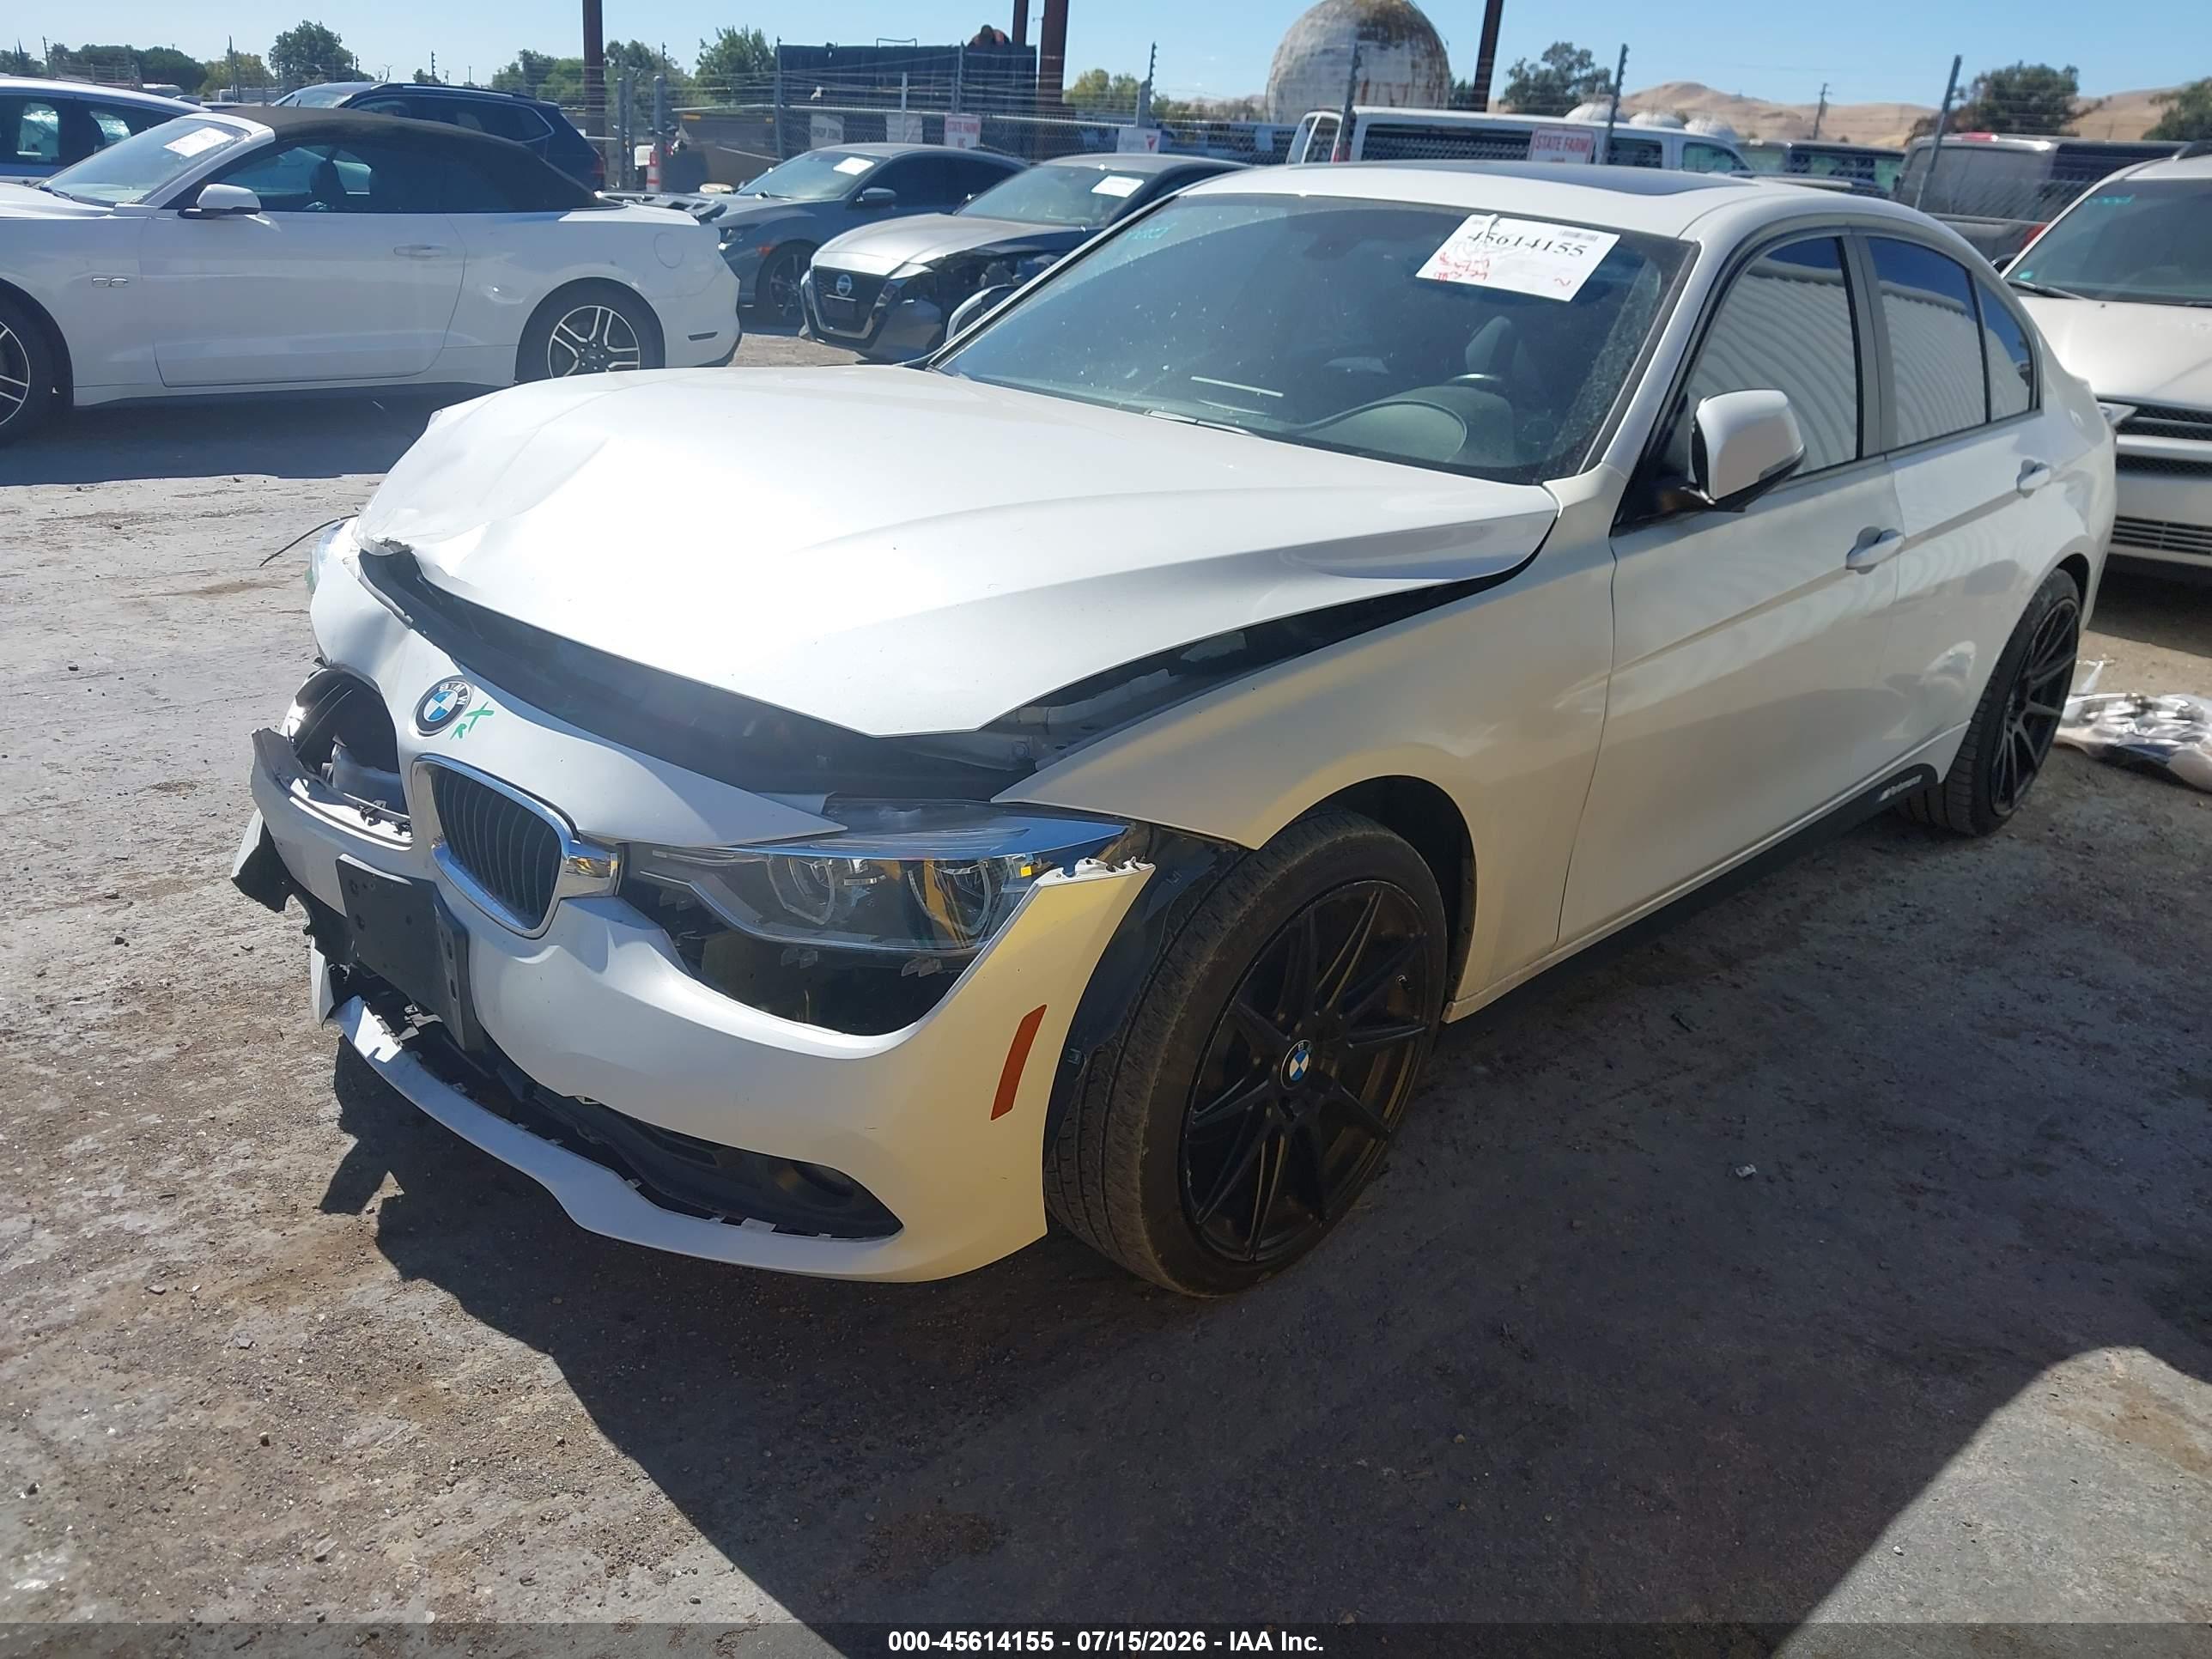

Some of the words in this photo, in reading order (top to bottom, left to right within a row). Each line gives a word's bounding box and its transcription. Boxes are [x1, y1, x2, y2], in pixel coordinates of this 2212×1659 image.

[1536, 135, 1564, 150] STATE
[1565, 137, 1589, 153] FARM
[439, 683, 468, 705] BMW
